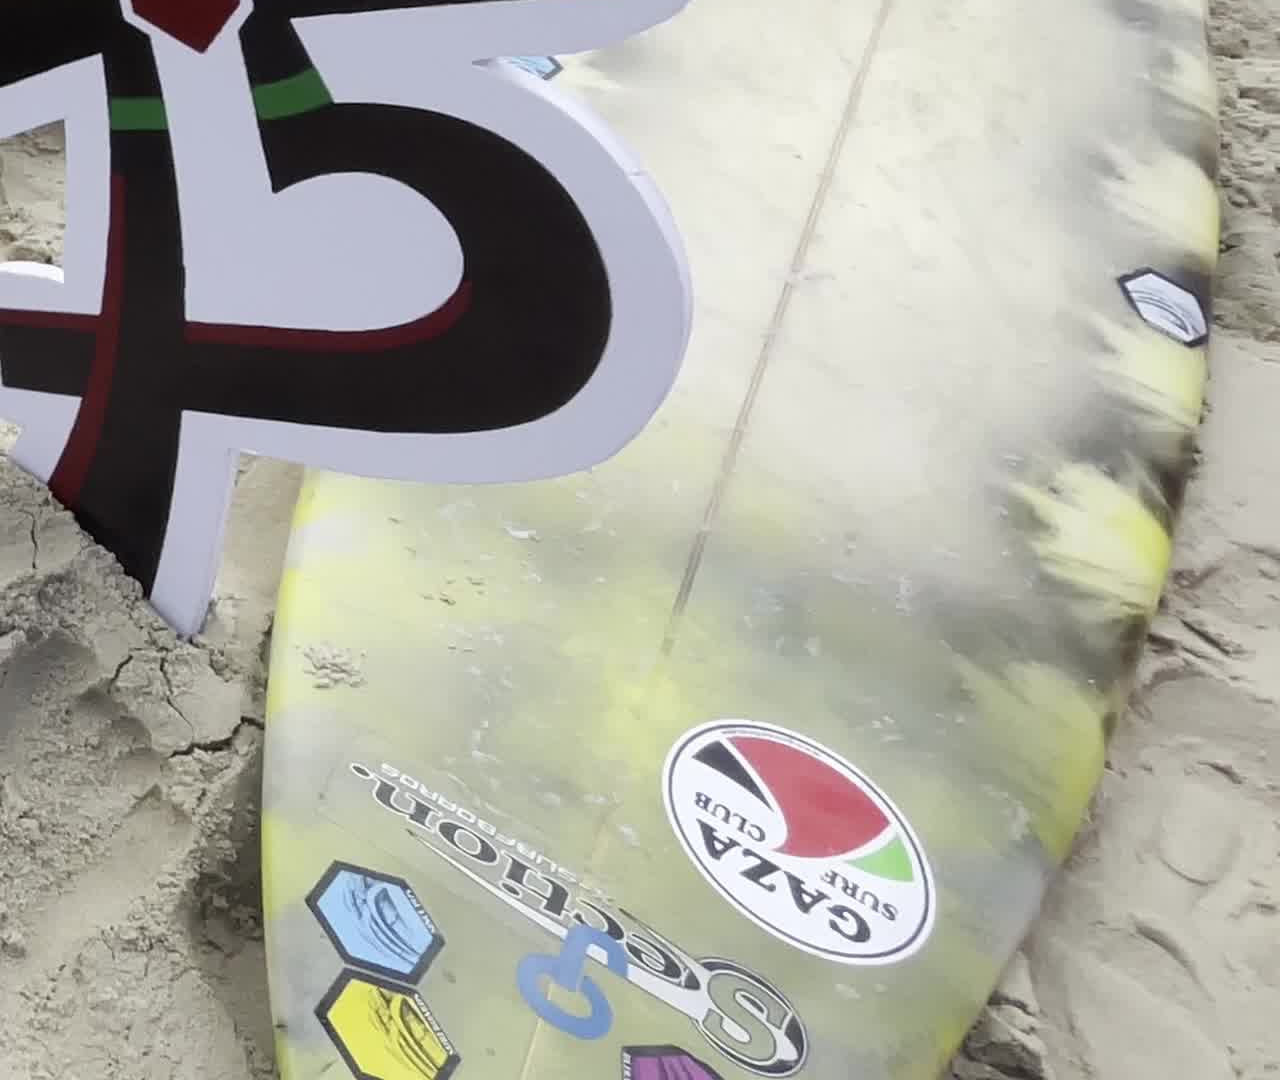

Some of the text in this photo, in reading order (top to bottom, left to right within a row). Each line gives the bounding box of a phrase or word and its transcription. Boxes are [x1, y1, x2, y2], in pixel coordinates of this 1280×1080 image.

[694, 791, 900, 922] SURF CLUB
[696, 817, 872, 944] GAZA
